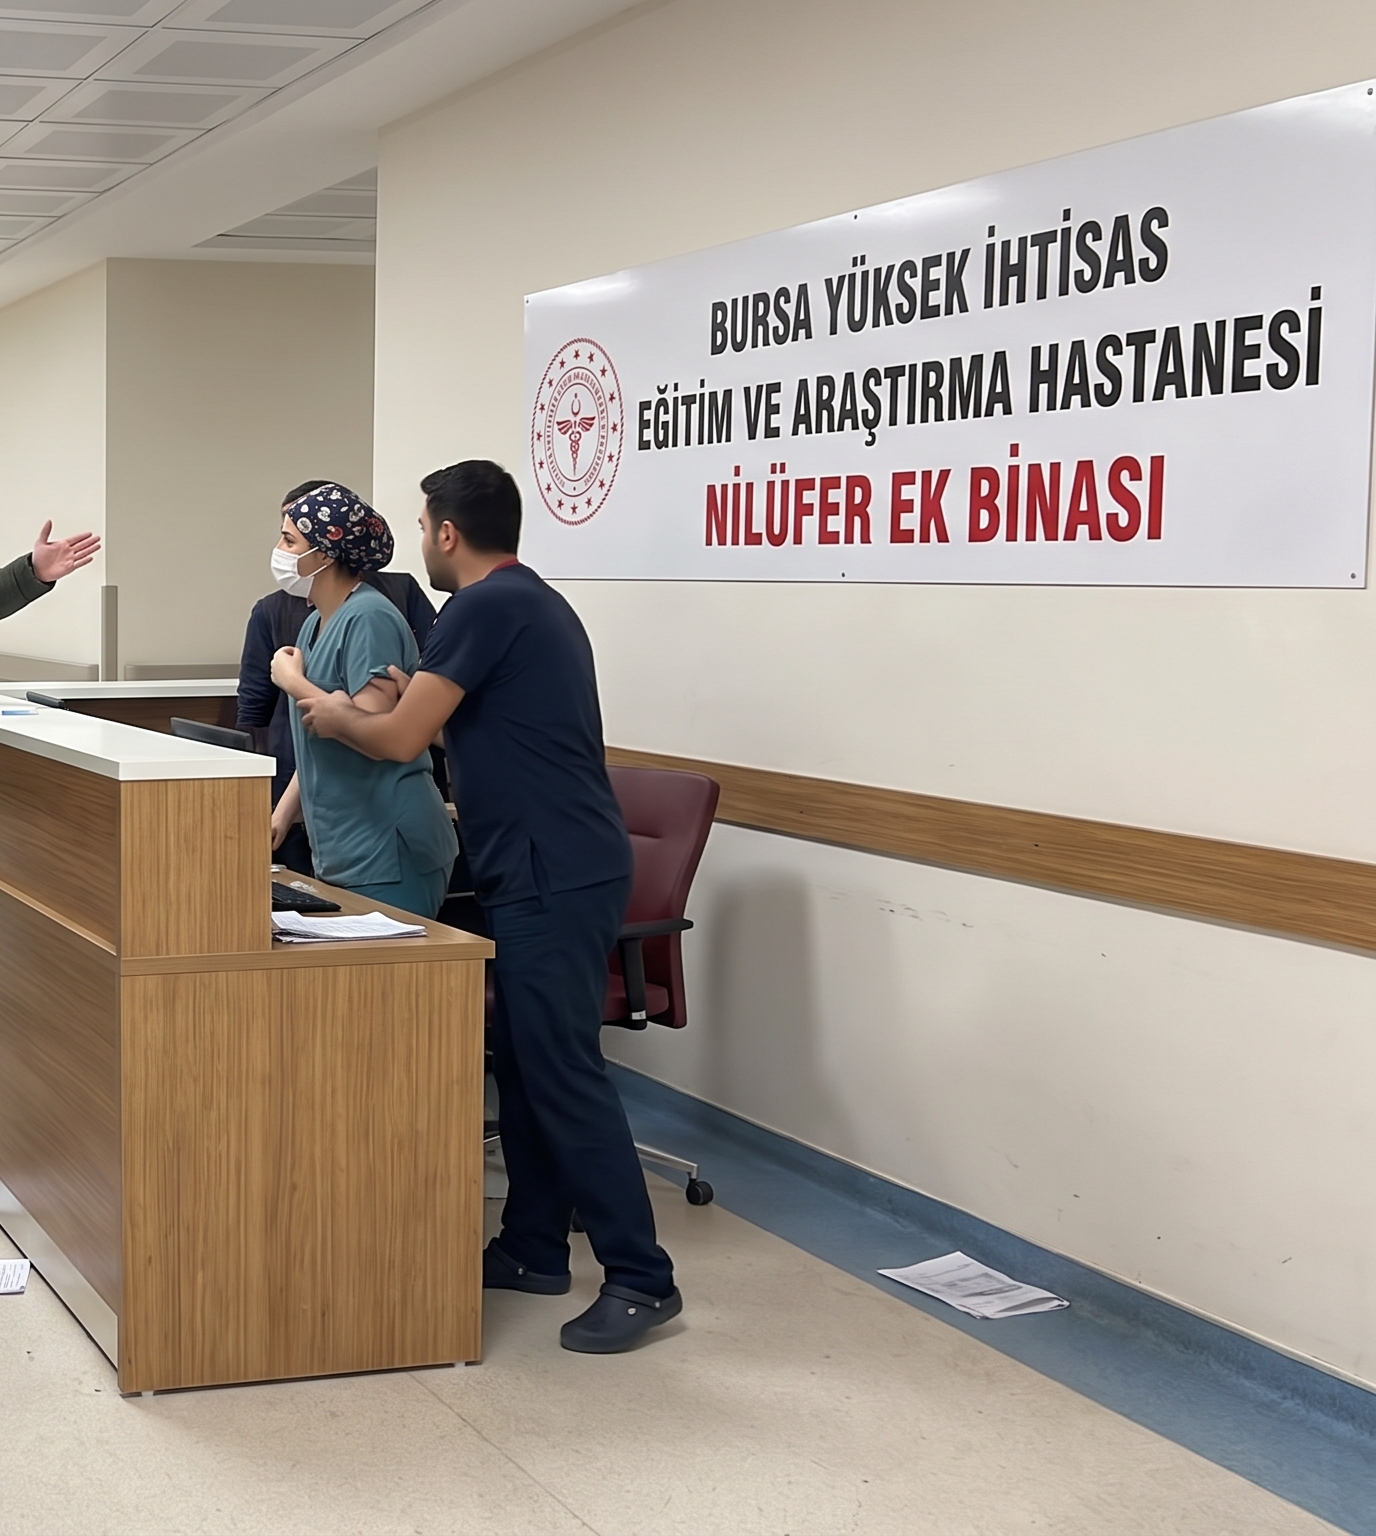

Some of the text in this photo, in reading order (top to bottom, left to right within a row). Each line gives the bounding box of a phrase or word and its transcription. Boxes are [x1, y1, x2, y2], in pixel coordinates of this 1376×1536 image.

[710, 206, 1169, 356] BURSA YÜKSEK İHTİSAS
[637, 378, 733, 451] EĞİTİM
[743, 381, 782, 441] VE
[791, 350, 1013, 447] ARAŞTIRMA
[1028, 285, 1323, 414] HASTANESİ
[705, 442, 1165, 547] NİLÜFER EK BİNASI
